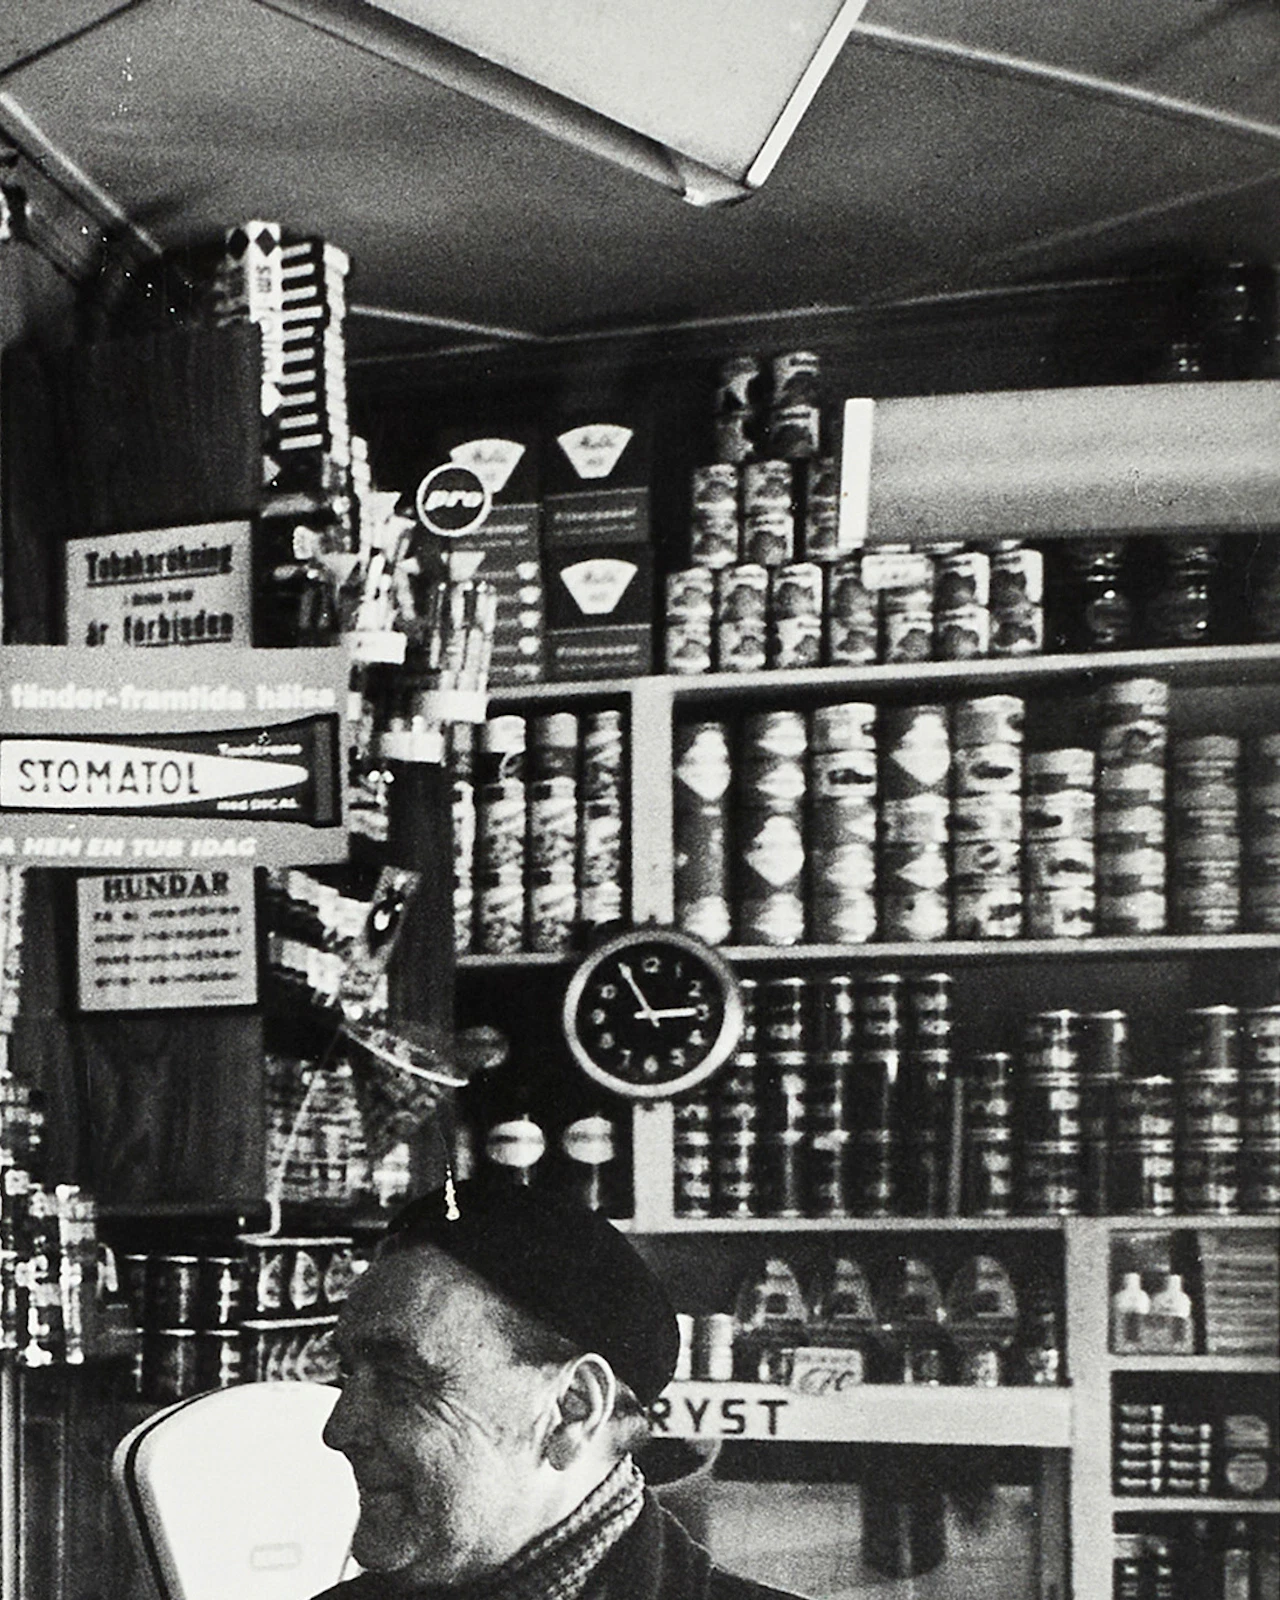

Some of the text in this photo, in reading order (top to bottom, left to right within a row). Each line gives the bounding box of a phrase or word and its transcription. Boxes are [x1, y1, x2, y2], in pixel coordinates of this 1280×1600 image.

[19, 758, 202, 796] STOMATOL
[87, 837, 125, 858] EN
[190, 837, 260, 858] IDAG
[102, 871, 230, 903] HUNDAR
[648, 1397, 789, 1436] RYST
